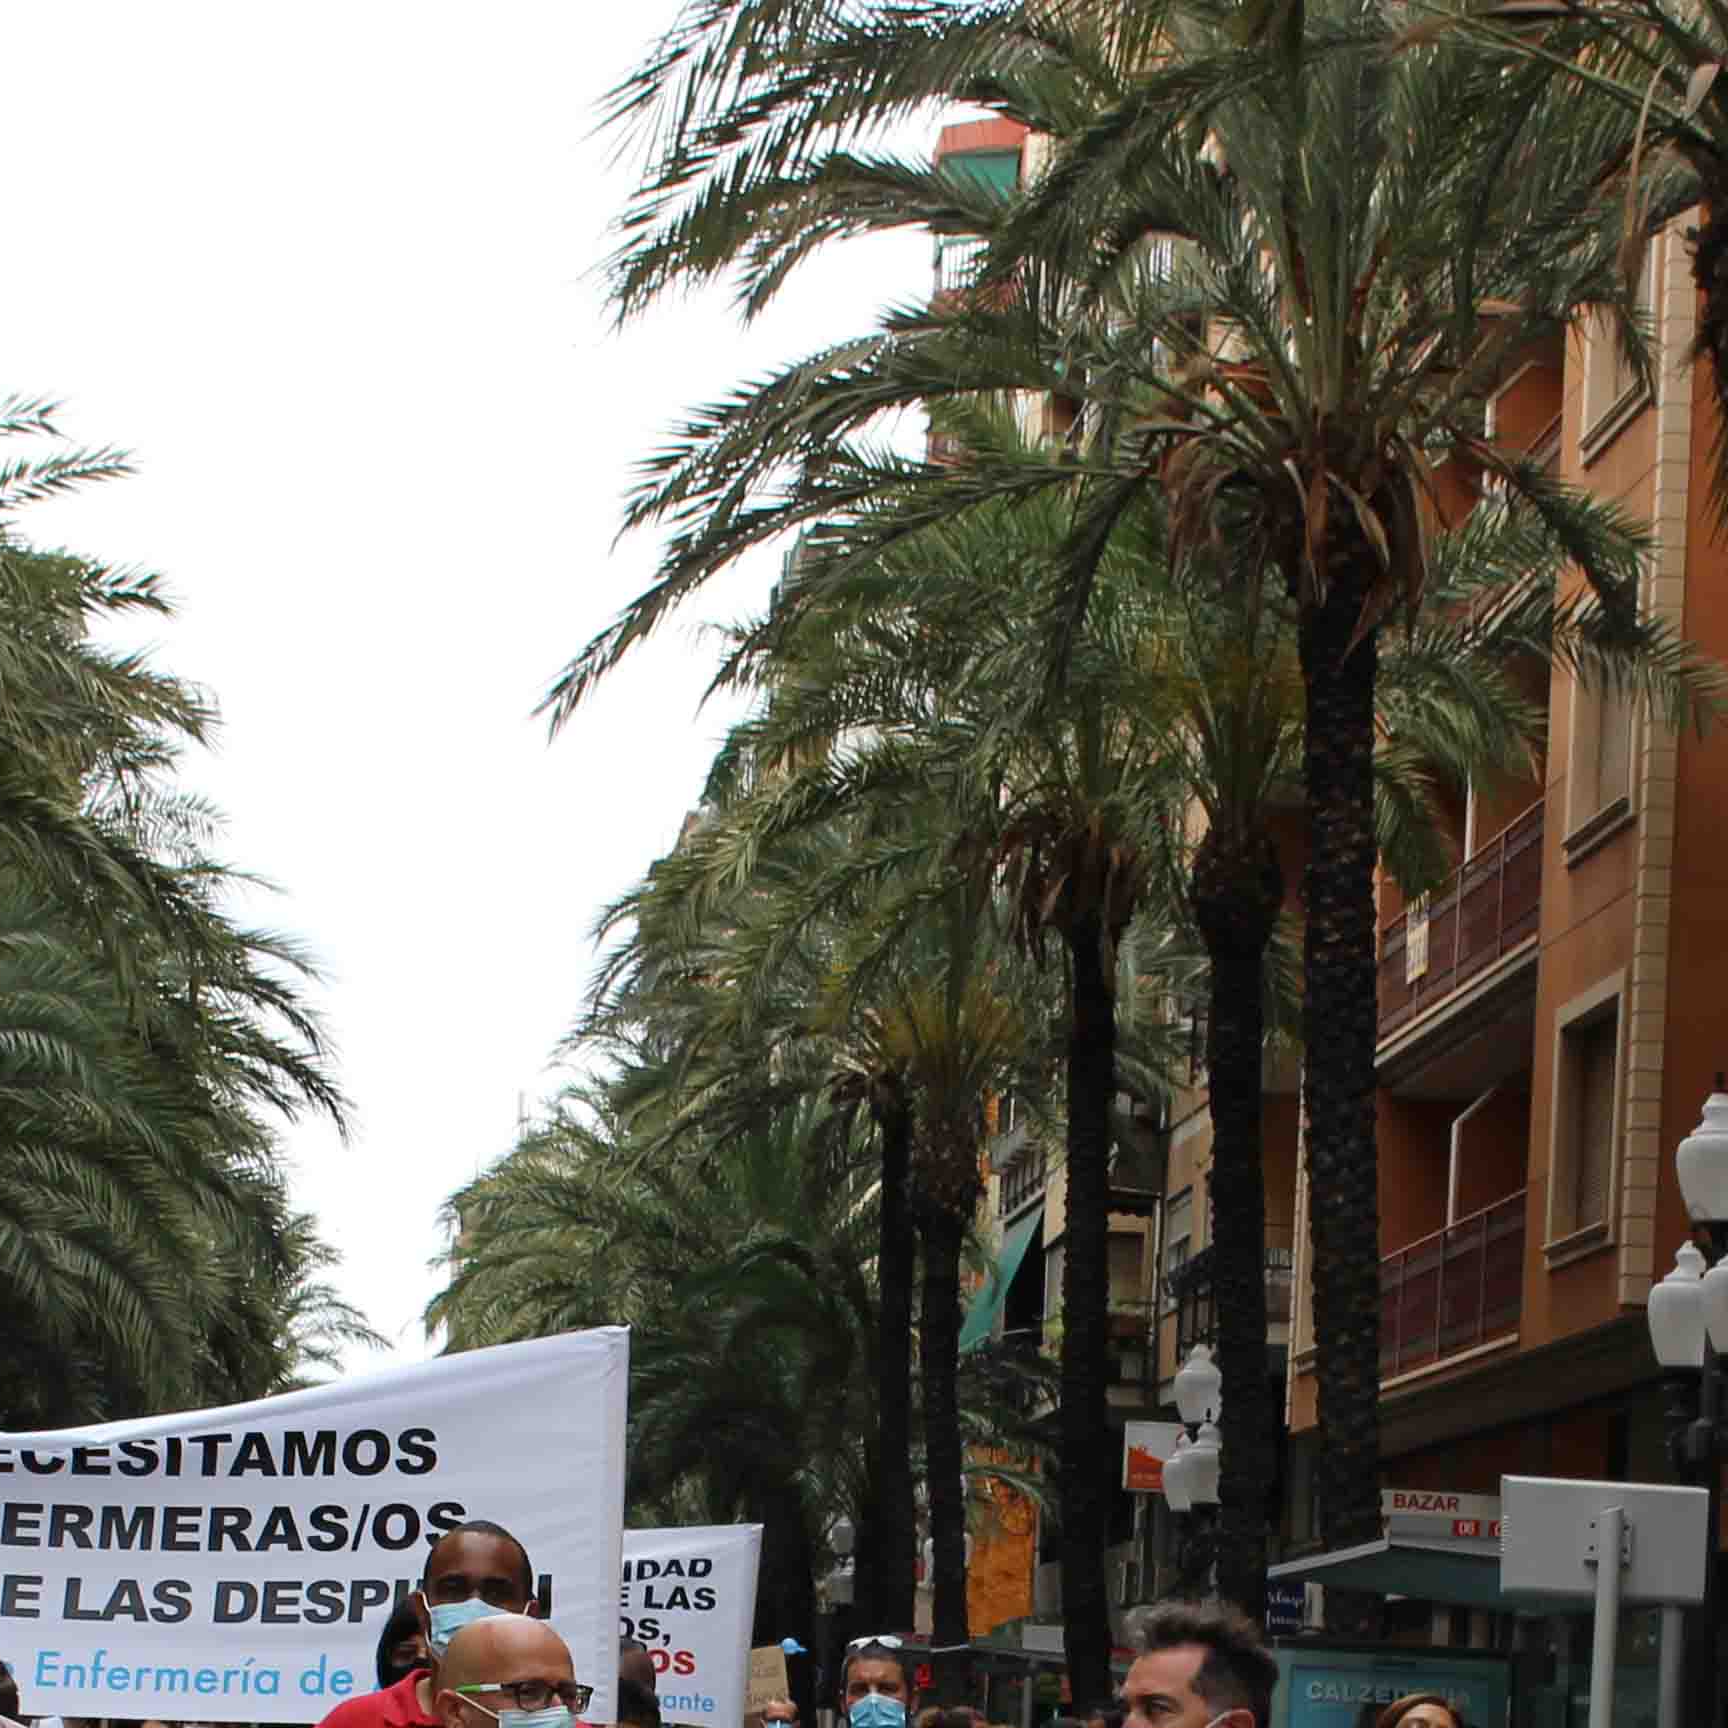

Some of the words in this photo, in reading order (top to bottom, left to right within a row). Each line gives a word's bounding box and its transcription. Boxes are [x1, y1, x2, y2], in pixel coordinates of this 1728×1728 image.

[1392, 1493, 1460, 1513] BAZAR
[622, 1557, 713, 1583] IDAD
[63, 1577, 192, 1623] LAS
[643, 1584, 718, 1612] LAS
[33, 1649, 283, 1698] Enfermería
[298, 1653, 354, 1697] de
[646, 1648, 697, 1676] OS
[662, 1692, 716, 1713] ante
